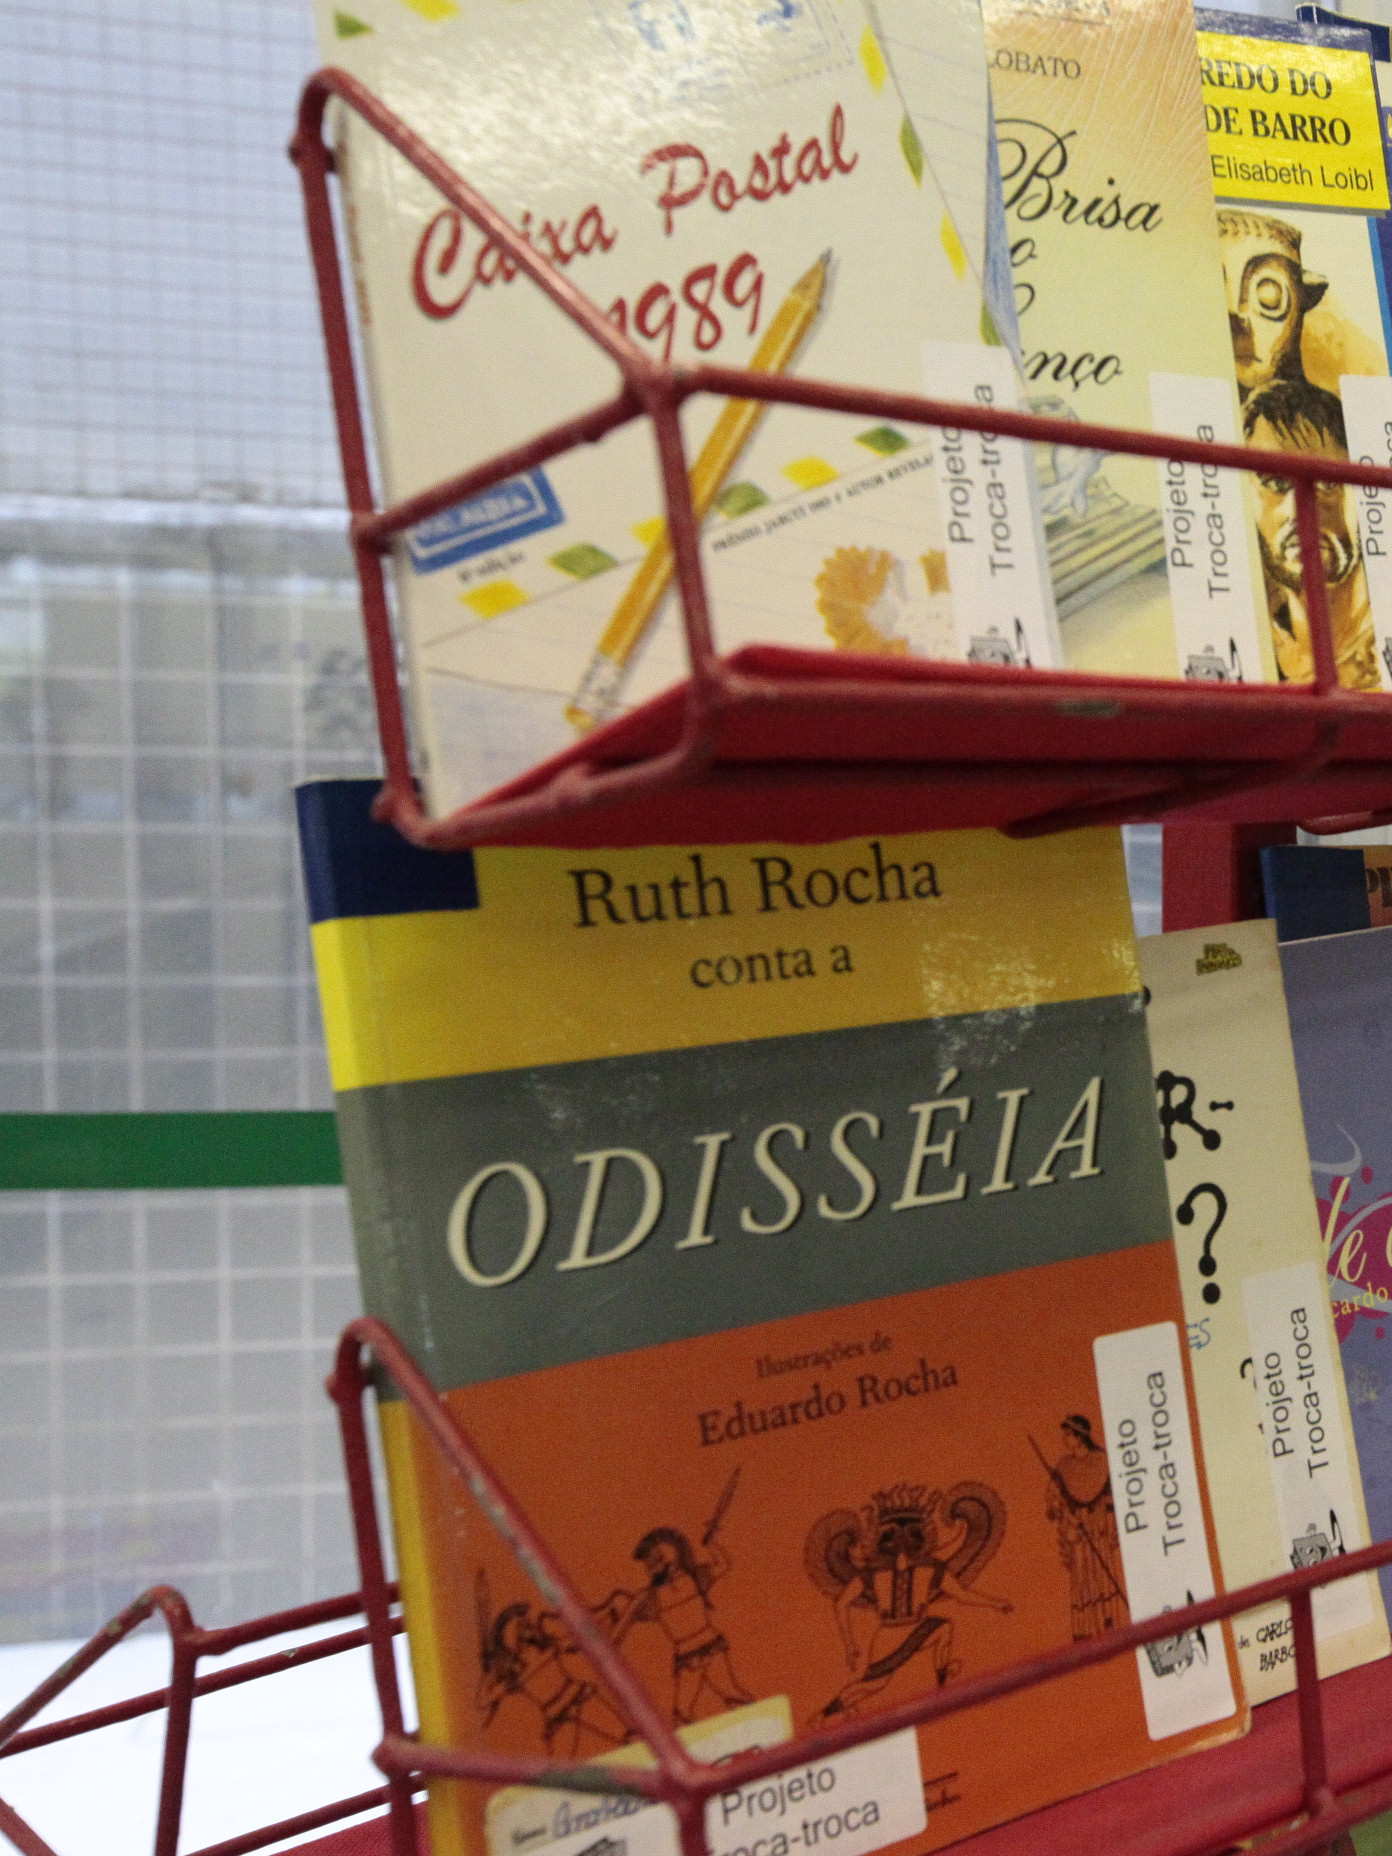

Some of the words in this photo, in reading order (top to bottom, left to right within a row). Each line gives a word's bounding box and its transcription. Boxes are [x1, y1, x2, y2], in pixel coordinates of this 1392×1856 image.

[1205, 103, 1240, 136] DE
[1251, 108, 1352, 147] BARRO
[1289, 68, 1332, 99] DO
[640, 103, 858, 236] Postal
[1211, 153, 1313, 187] Elisabeth
[1320, 159, 1374, 192] Loibl
[1019, 350, 1123, 391] nço
[974, 383, 1015, 577] Troca-troa
[1165, 458, 1196, 569] Projeto
[1197, 424, 1231, 600] Troca-troa
[1359, 455, 1388, 557] Projeo
[567, 854, 734, 929] Ruth
[751, 841, 943, 914] Rocha
[690, 945, 813, 990] conta
[828, 944, 855, 977] a
[446, 1067, 1105, 1290] ODISSÉIA
[696, 1383, 847, 1448] Eduardo
[857, 1357, 961, 1411] Rocha
[1263, 1351, 1294, 1459] Projeto
[1290, 1307, 1330, 1479] Troca-troca
[1116, 1418, 1149, 1535] Projeto
[1146, 1370, 1186, 1557] Troca-troca
[712, 1798, 882, 1856] roca-troca
[720, 1765, 837, 1826] Projeto
